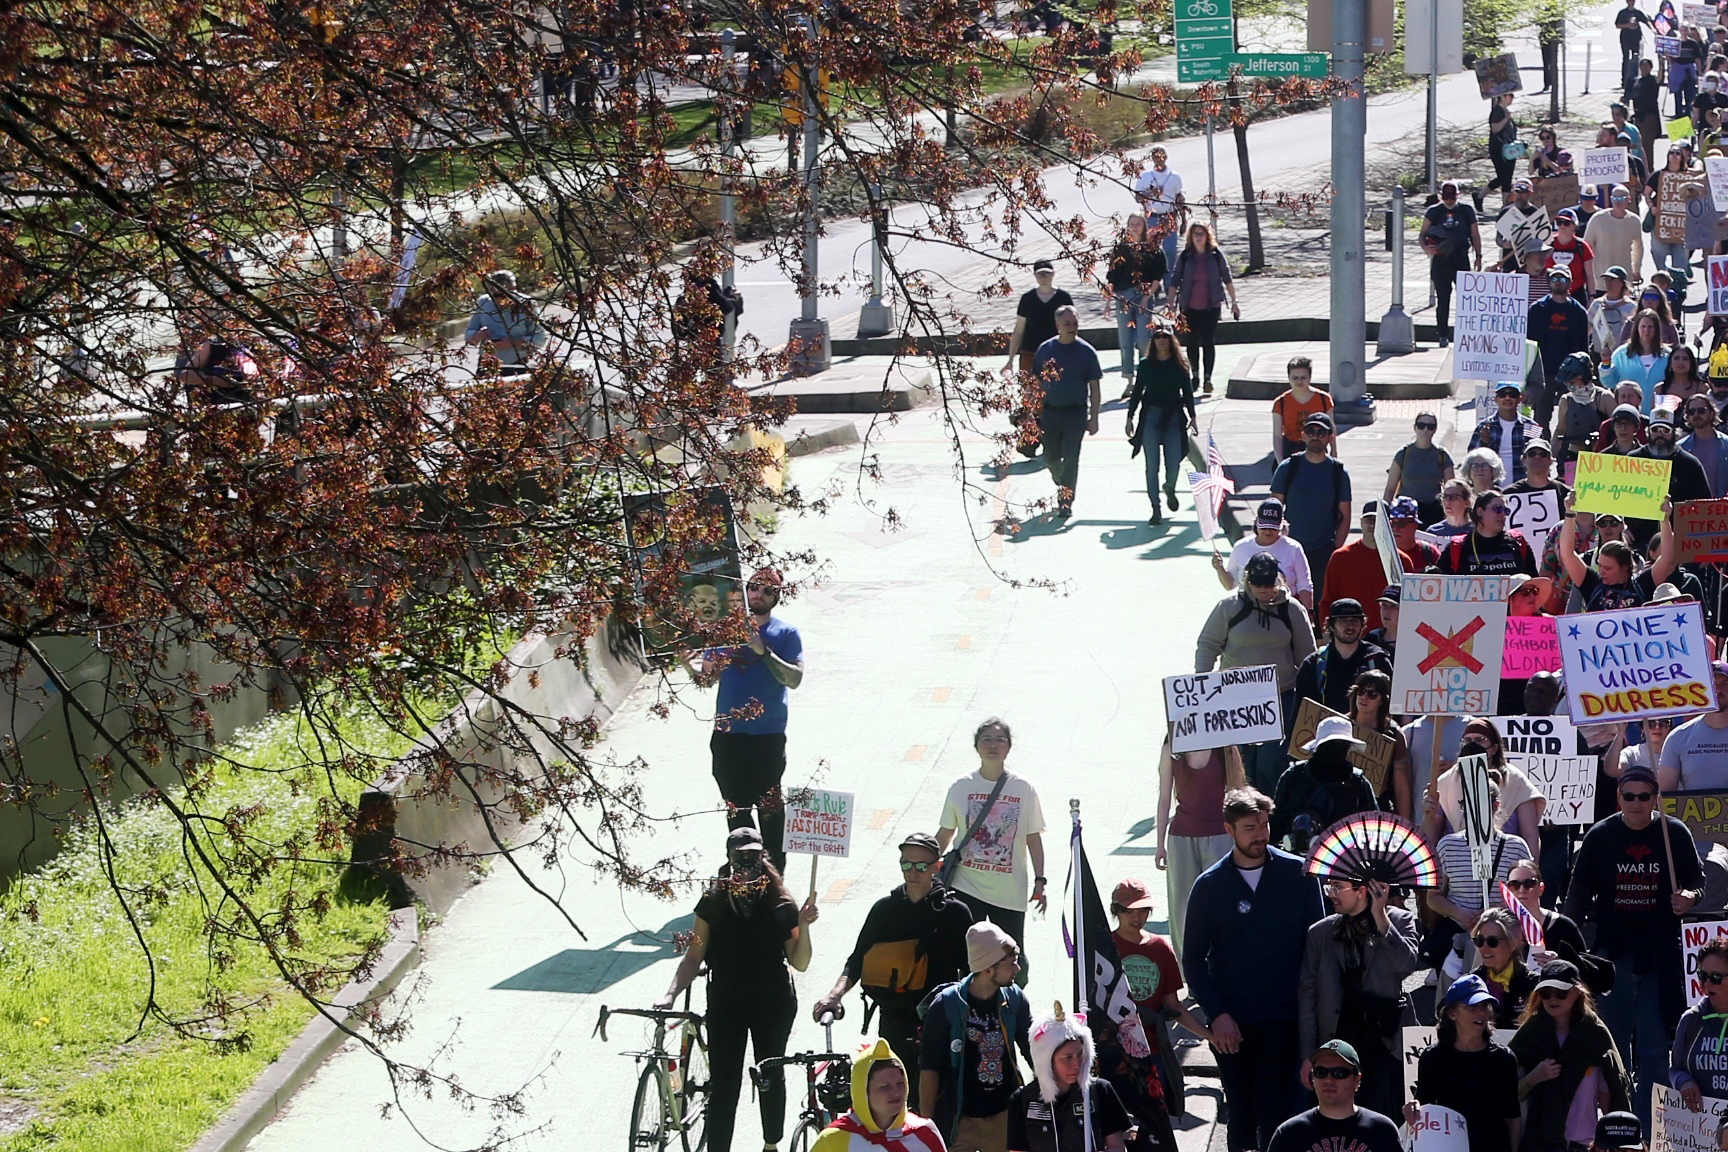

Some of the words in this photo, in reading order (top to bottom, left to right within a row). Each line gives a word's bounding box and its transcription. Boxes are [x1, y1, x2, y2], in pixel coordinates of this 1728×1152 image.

[1246, 59, 1299, 72] Jefferson
[1587, 154, 1622, 164] PROTECT
[1580, 165, 1626, 177] DEMOCRACY
[1464, 273, 1486, 292] DO
[1495, 276, 1522, 295] NOT
[1462, 296, 1526, 314] MISTREAT
[1458, 316, 1476, 330] THE
[1480, 315, 1528, 334] FOREIGNER
[1458, 335, 1498, 354] AMONG
[1503, 338, 1520, 356] YOU
[1462, 362, 1490, 372] LEVITICUS
[1578, 454, 1602, 473] NO
[1612, 455, 1670, 482] KINGS!
[1681, 540, 1702, 552] NO
[1402, 578, 1441, 602] NO
[1446, 578, 1509, 602] WAR!
[1596, 613, 1669, 640] ONE
[1578, 632, 1690, 673] NATION
[1431, 668, 1467, 690] NO
[1598, 662, 1692, 689] UNDER
[1173, 676, 1209, 696] CUT
[1176, 696, 1199, 708] CIS
[1221, 665, 1276, 688] NORMATIVITY
[1406, 690, 1490, 712] KINGS!
[1579, 682, 1710, 717] DURESS
[1176, 712, 1198, 738] NOT
[1204, 700, 1277, 733] FORESKINS
[1508, 720, 1554, 736] NO
[1458, 756, 1492, 846] NO
[1561, 784, 1594, 800] FIND
[824, 793, 847, 814] Rule
[794, 808, 818, 819] TRUMP
[792, 819, 848, 838] ASSHOLES
[788, 840, 806, 851] Stop
[809, 840, 822, 852] the
[992, 865, 1013, 874] TIMES
[1617, 863, 1645, 873] WAR
[1650, 863, 1660, 873] IS
[1616, 874, 1659, 884] PEACE
[1684, 926, 1708, 948] NO
[1702, 1037, 1718, 1052] NO
